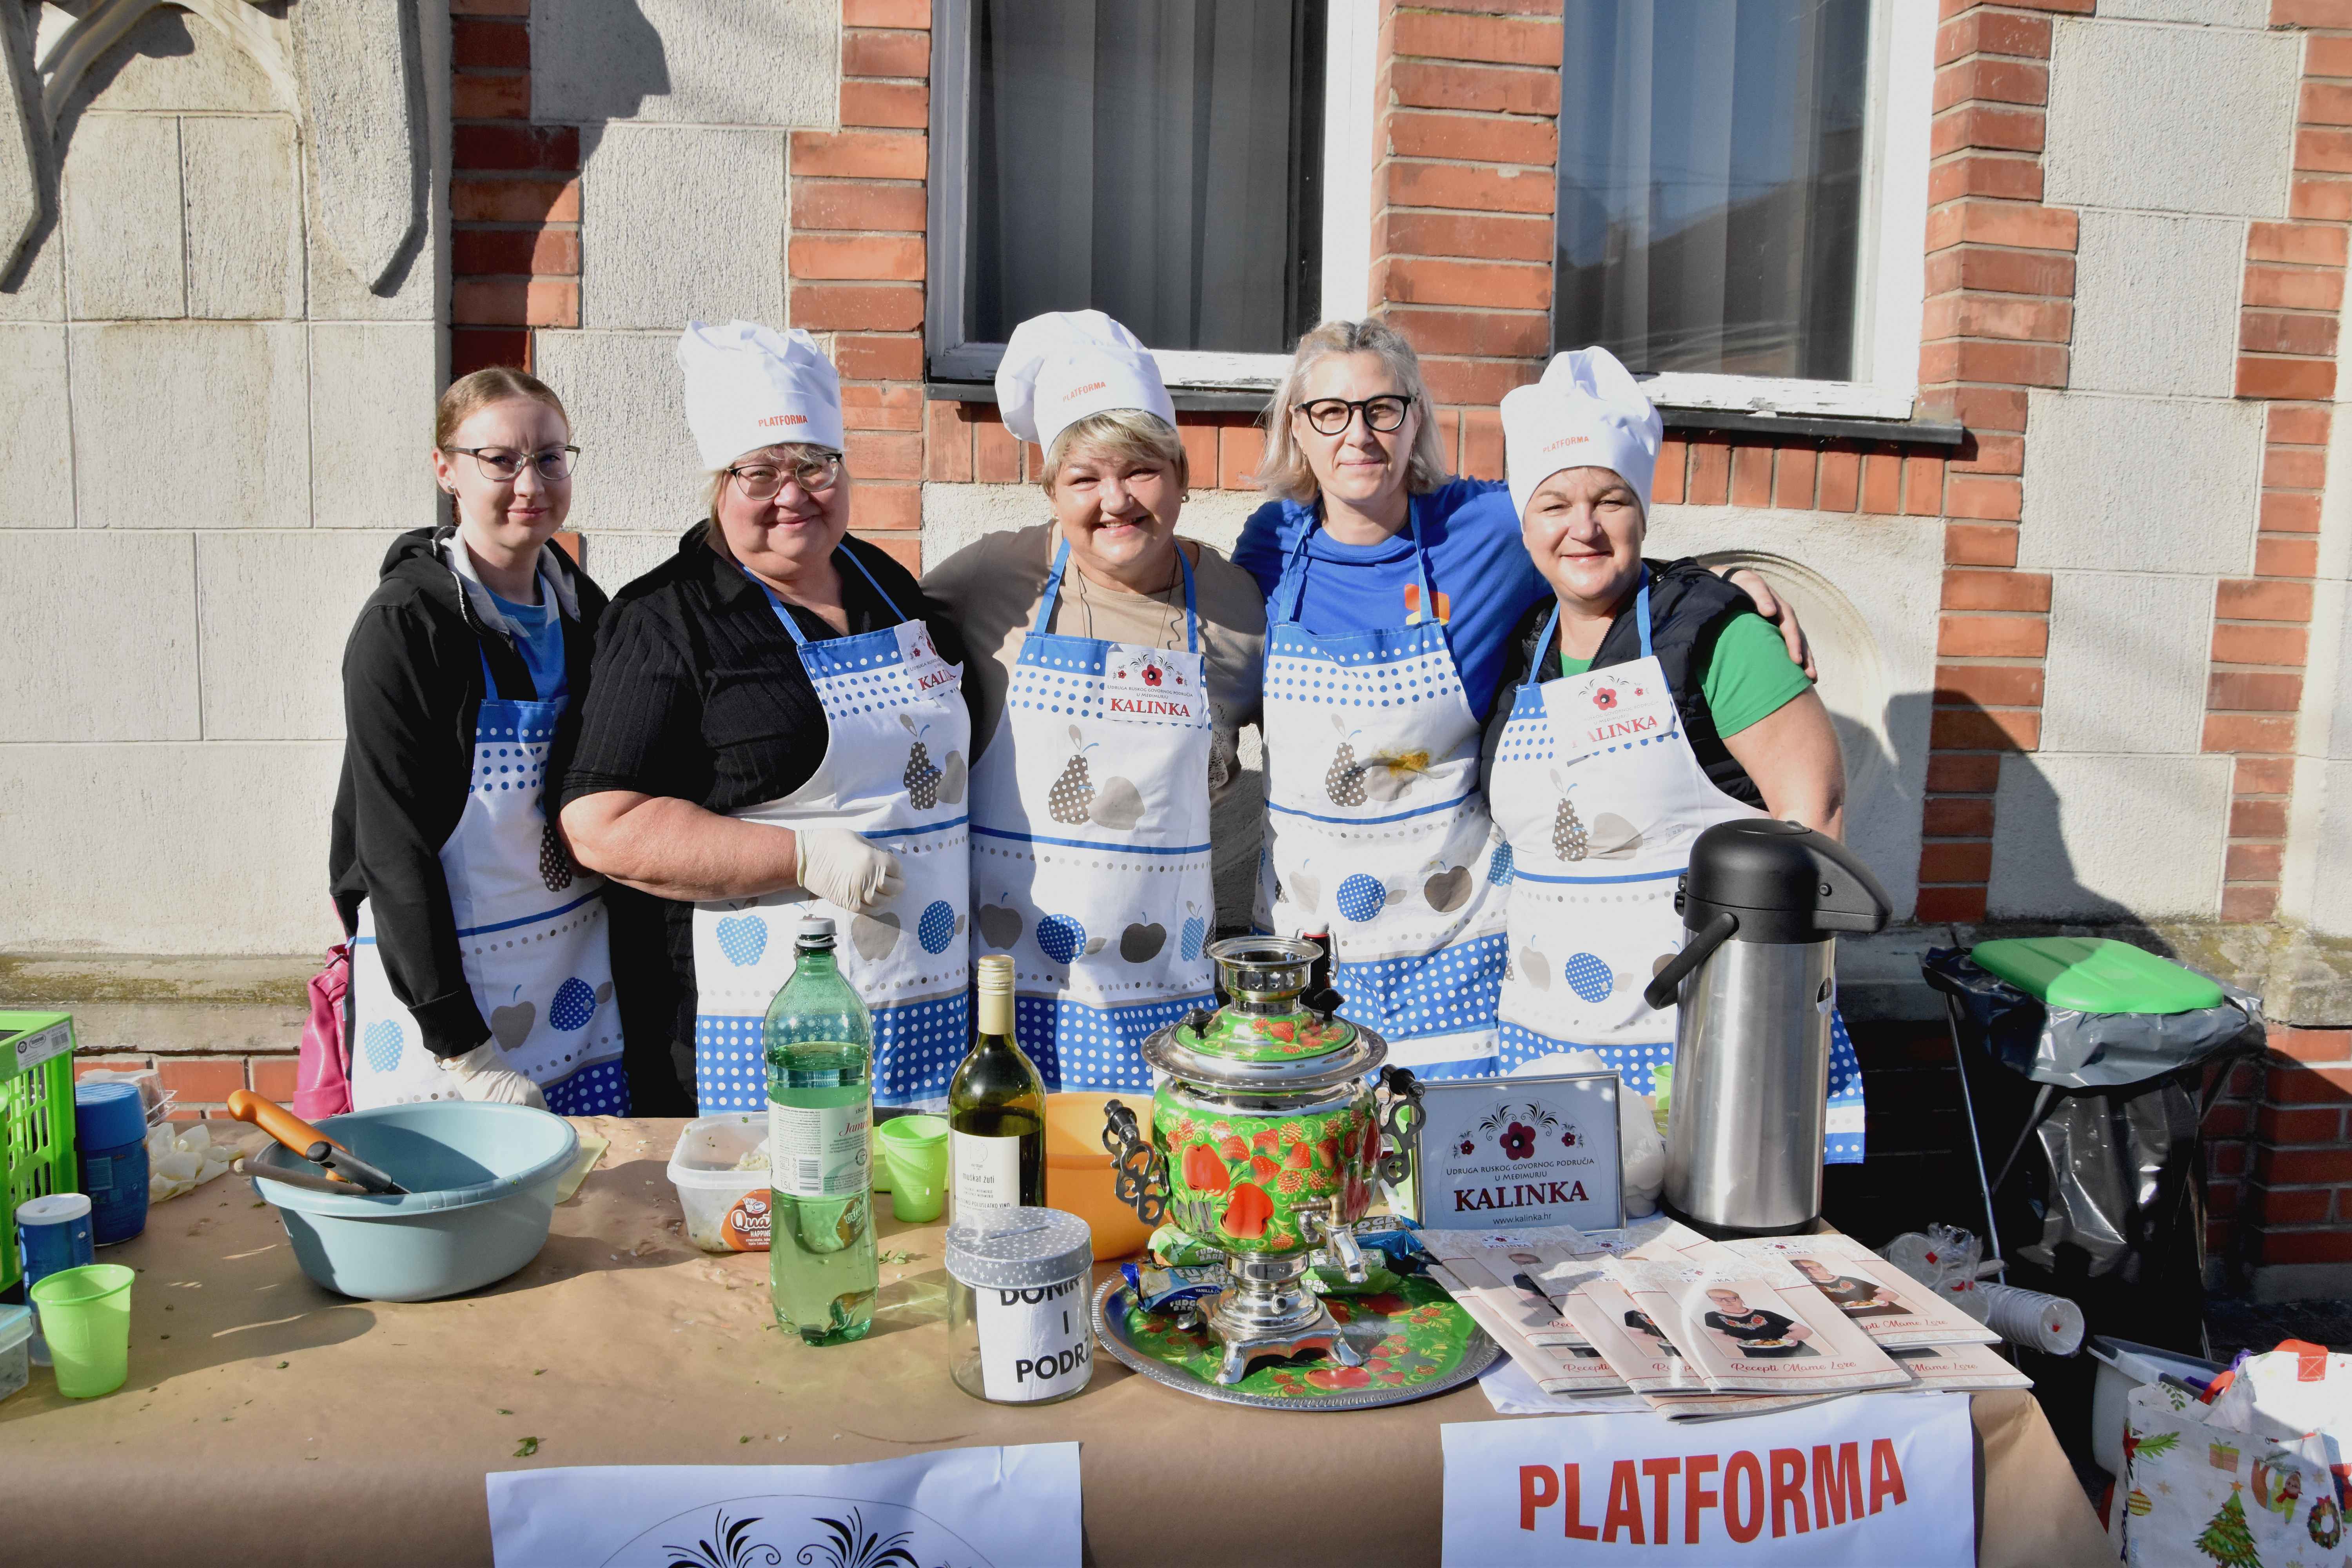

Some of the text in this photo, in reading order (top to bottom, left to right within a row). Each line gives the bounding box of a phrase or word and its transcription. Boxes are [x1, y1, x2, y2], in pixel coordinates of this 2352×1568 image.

[1063, 381, 1106, 403] PLATFORMA
[758, 414, 808, 427] PLATFORMA
[1543, 436, 1590, 454] PLATFORMA
[1110, 698, 1191, 717] KALINKA
[855, 1105, 867, 1114] 1828
[1446, 1157, 1594, 1176] UDRUGA RUSKOG GOVORNOG PODRUČJA
[1503, 1171, 1547, 1180] MEĐIMURJU
[1454, 1180, 1589, 1212] KALINKA
[1493, 1212, 1552, 1225] www.kalinka.hr
[1063, 1310, 1069, 1334] I
[1563, 1364, 1609, 1372] Recepti
[1731, 1361, 1857, 1373] Recepti Mame Lore
[1908, 1363, 1950, 1372] Mame
[1519, 1437, 1908, 1545] PLATFORMA
